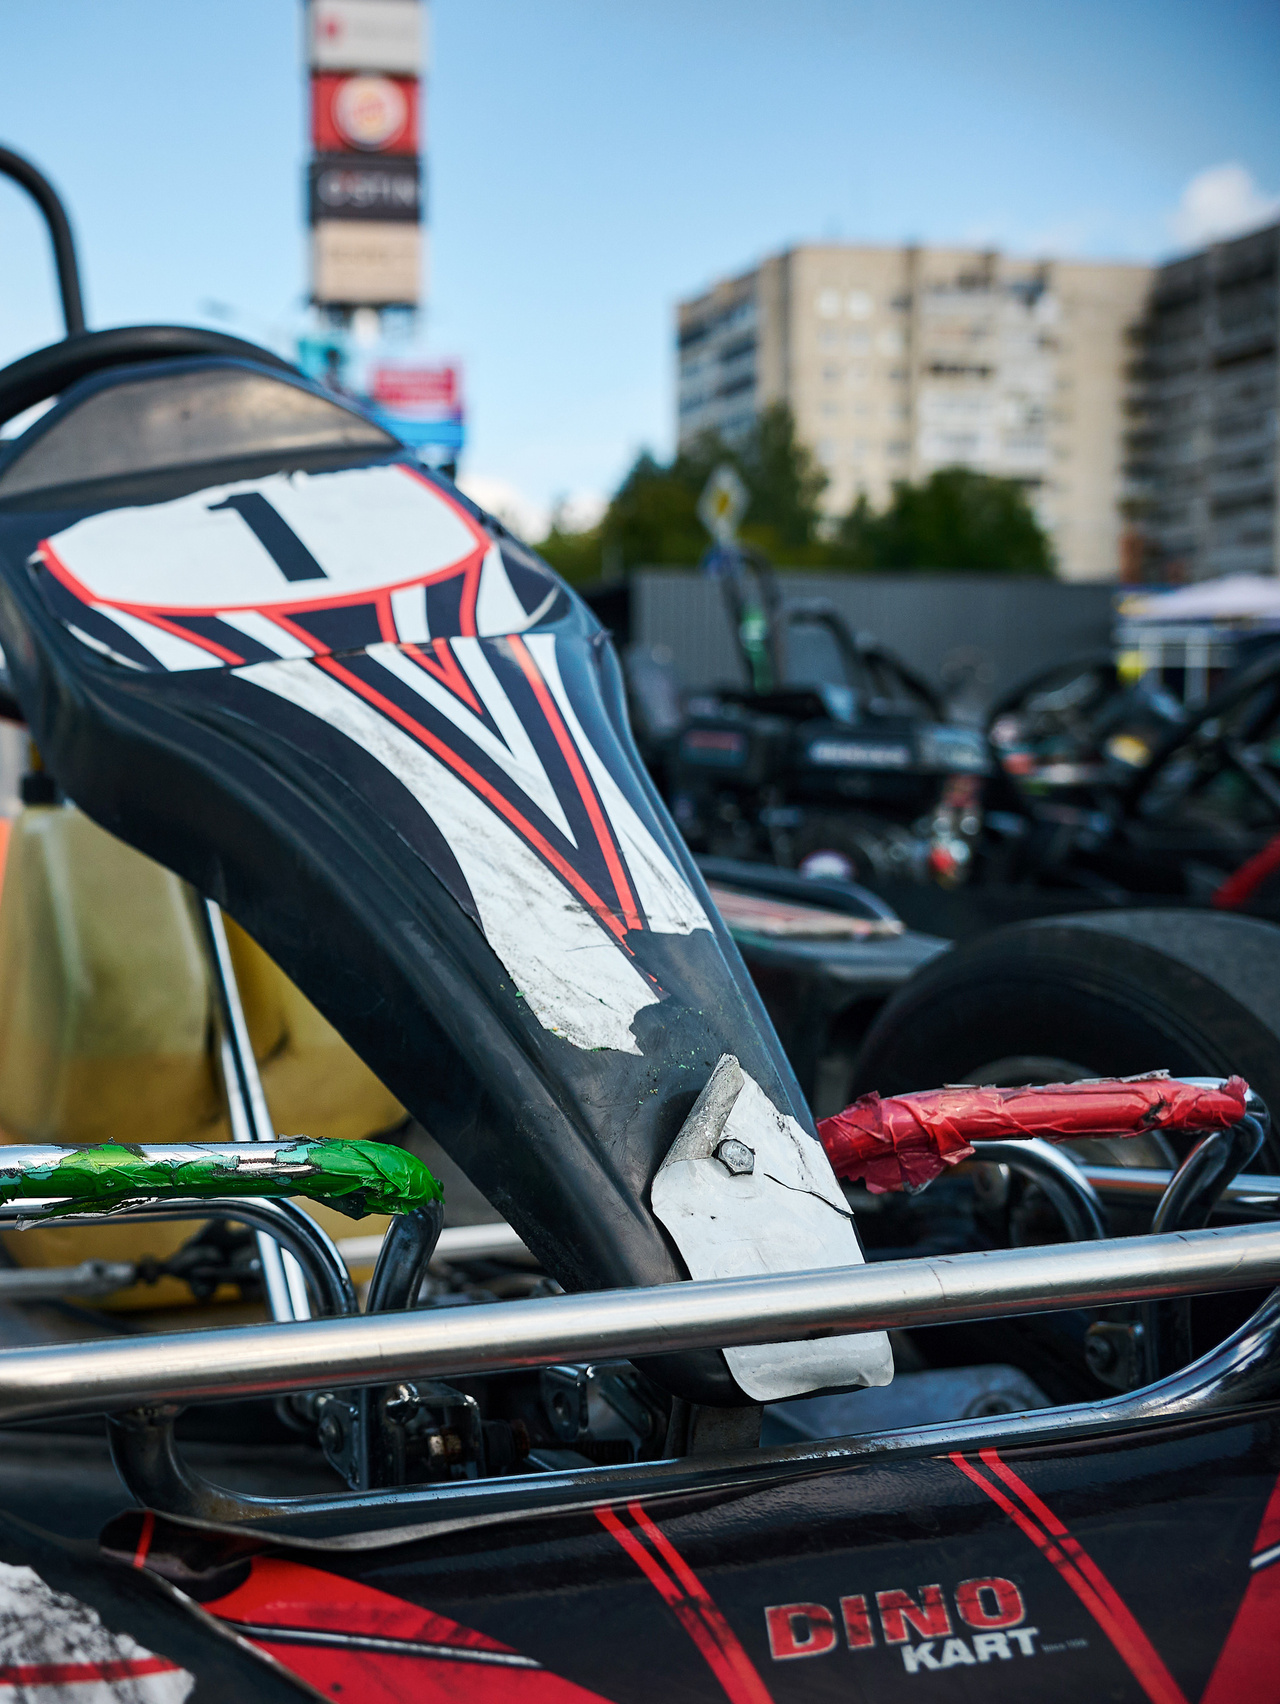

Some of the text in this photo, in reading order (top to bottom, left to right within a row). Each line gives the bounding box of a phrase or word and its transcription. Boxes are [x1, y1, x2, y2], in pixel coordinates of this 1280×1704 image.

[206, 491, 329, 583] 1
[764, 1576, 1026, 1661] DINO
[901, 1627, 1039, 1674] KART
